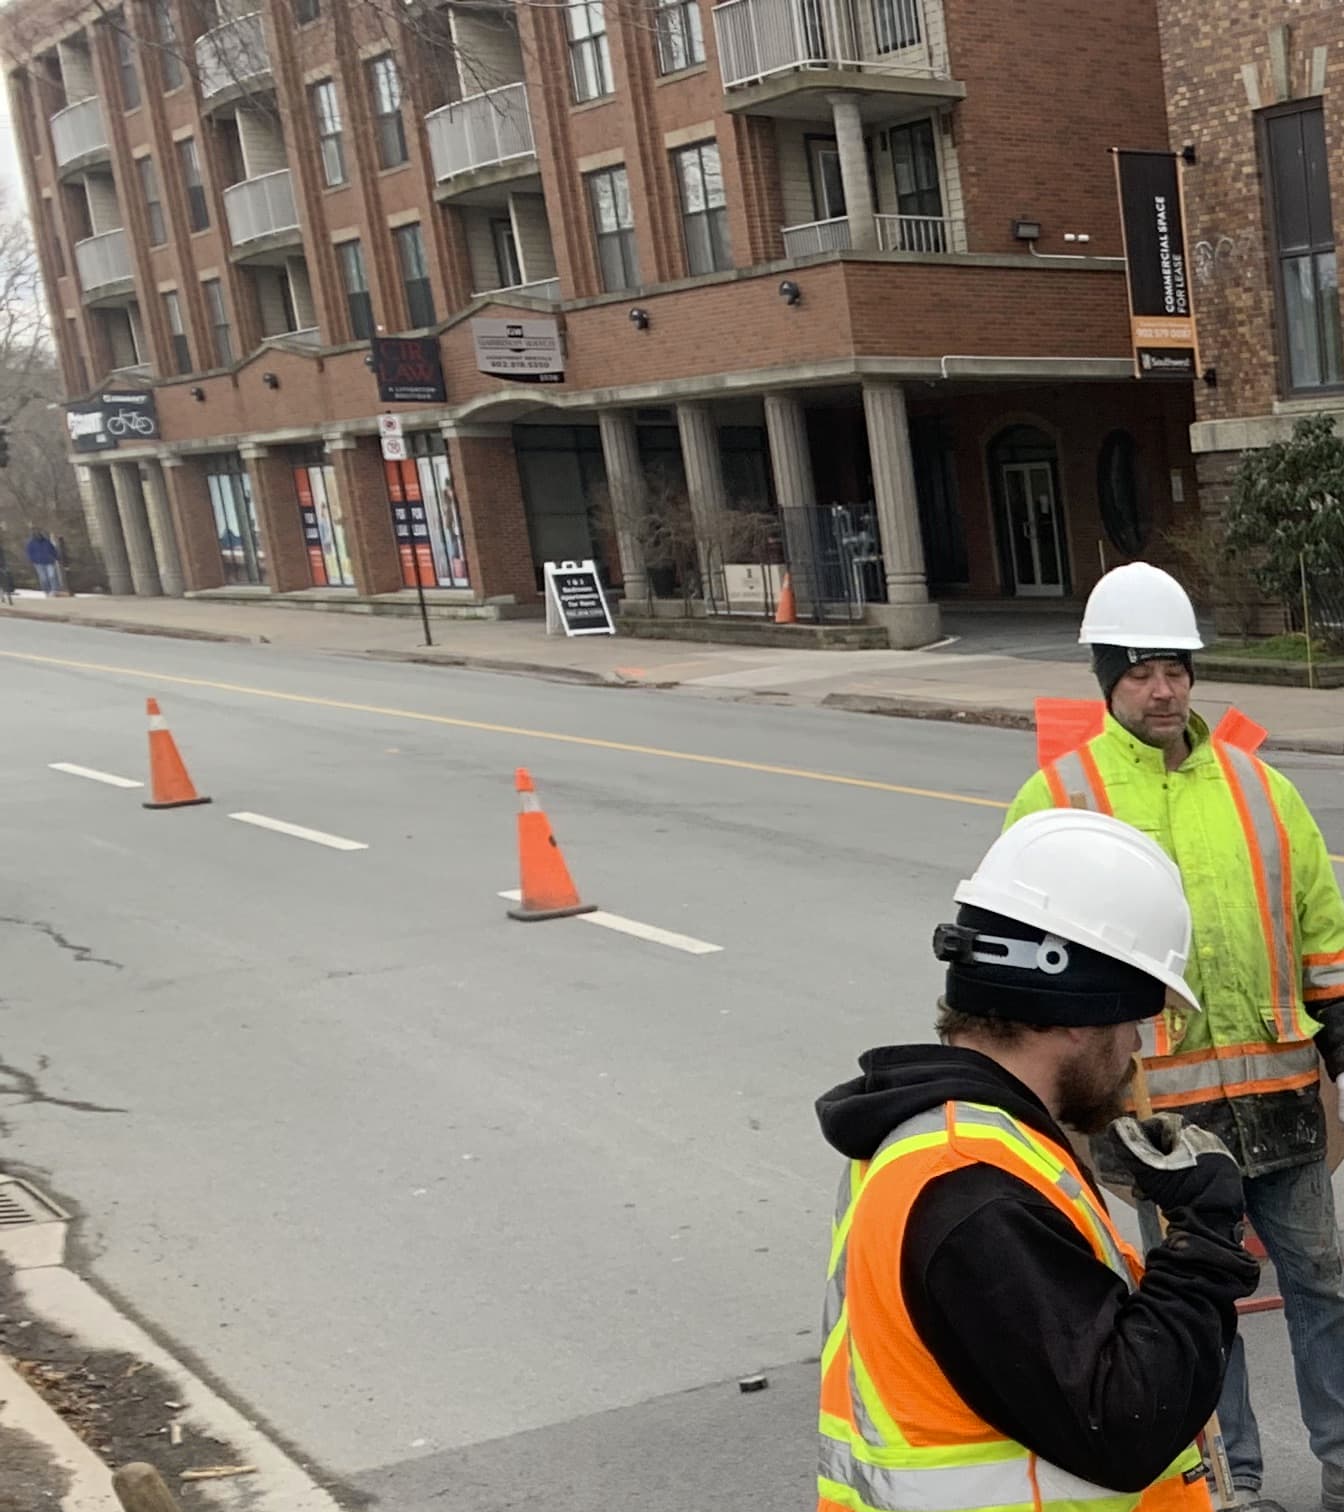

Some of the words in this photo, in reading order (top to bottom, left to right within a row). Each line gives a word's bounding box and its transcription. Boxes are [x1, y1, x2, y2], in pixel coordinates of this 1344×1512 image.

[1154, 196, 1168, 232] SPACE
[1160, 234, 1175, 313] COMMERCIAL
[1172, 254, 1185, 288] LEASE
[1175, 289, 1187, 314] FOR
